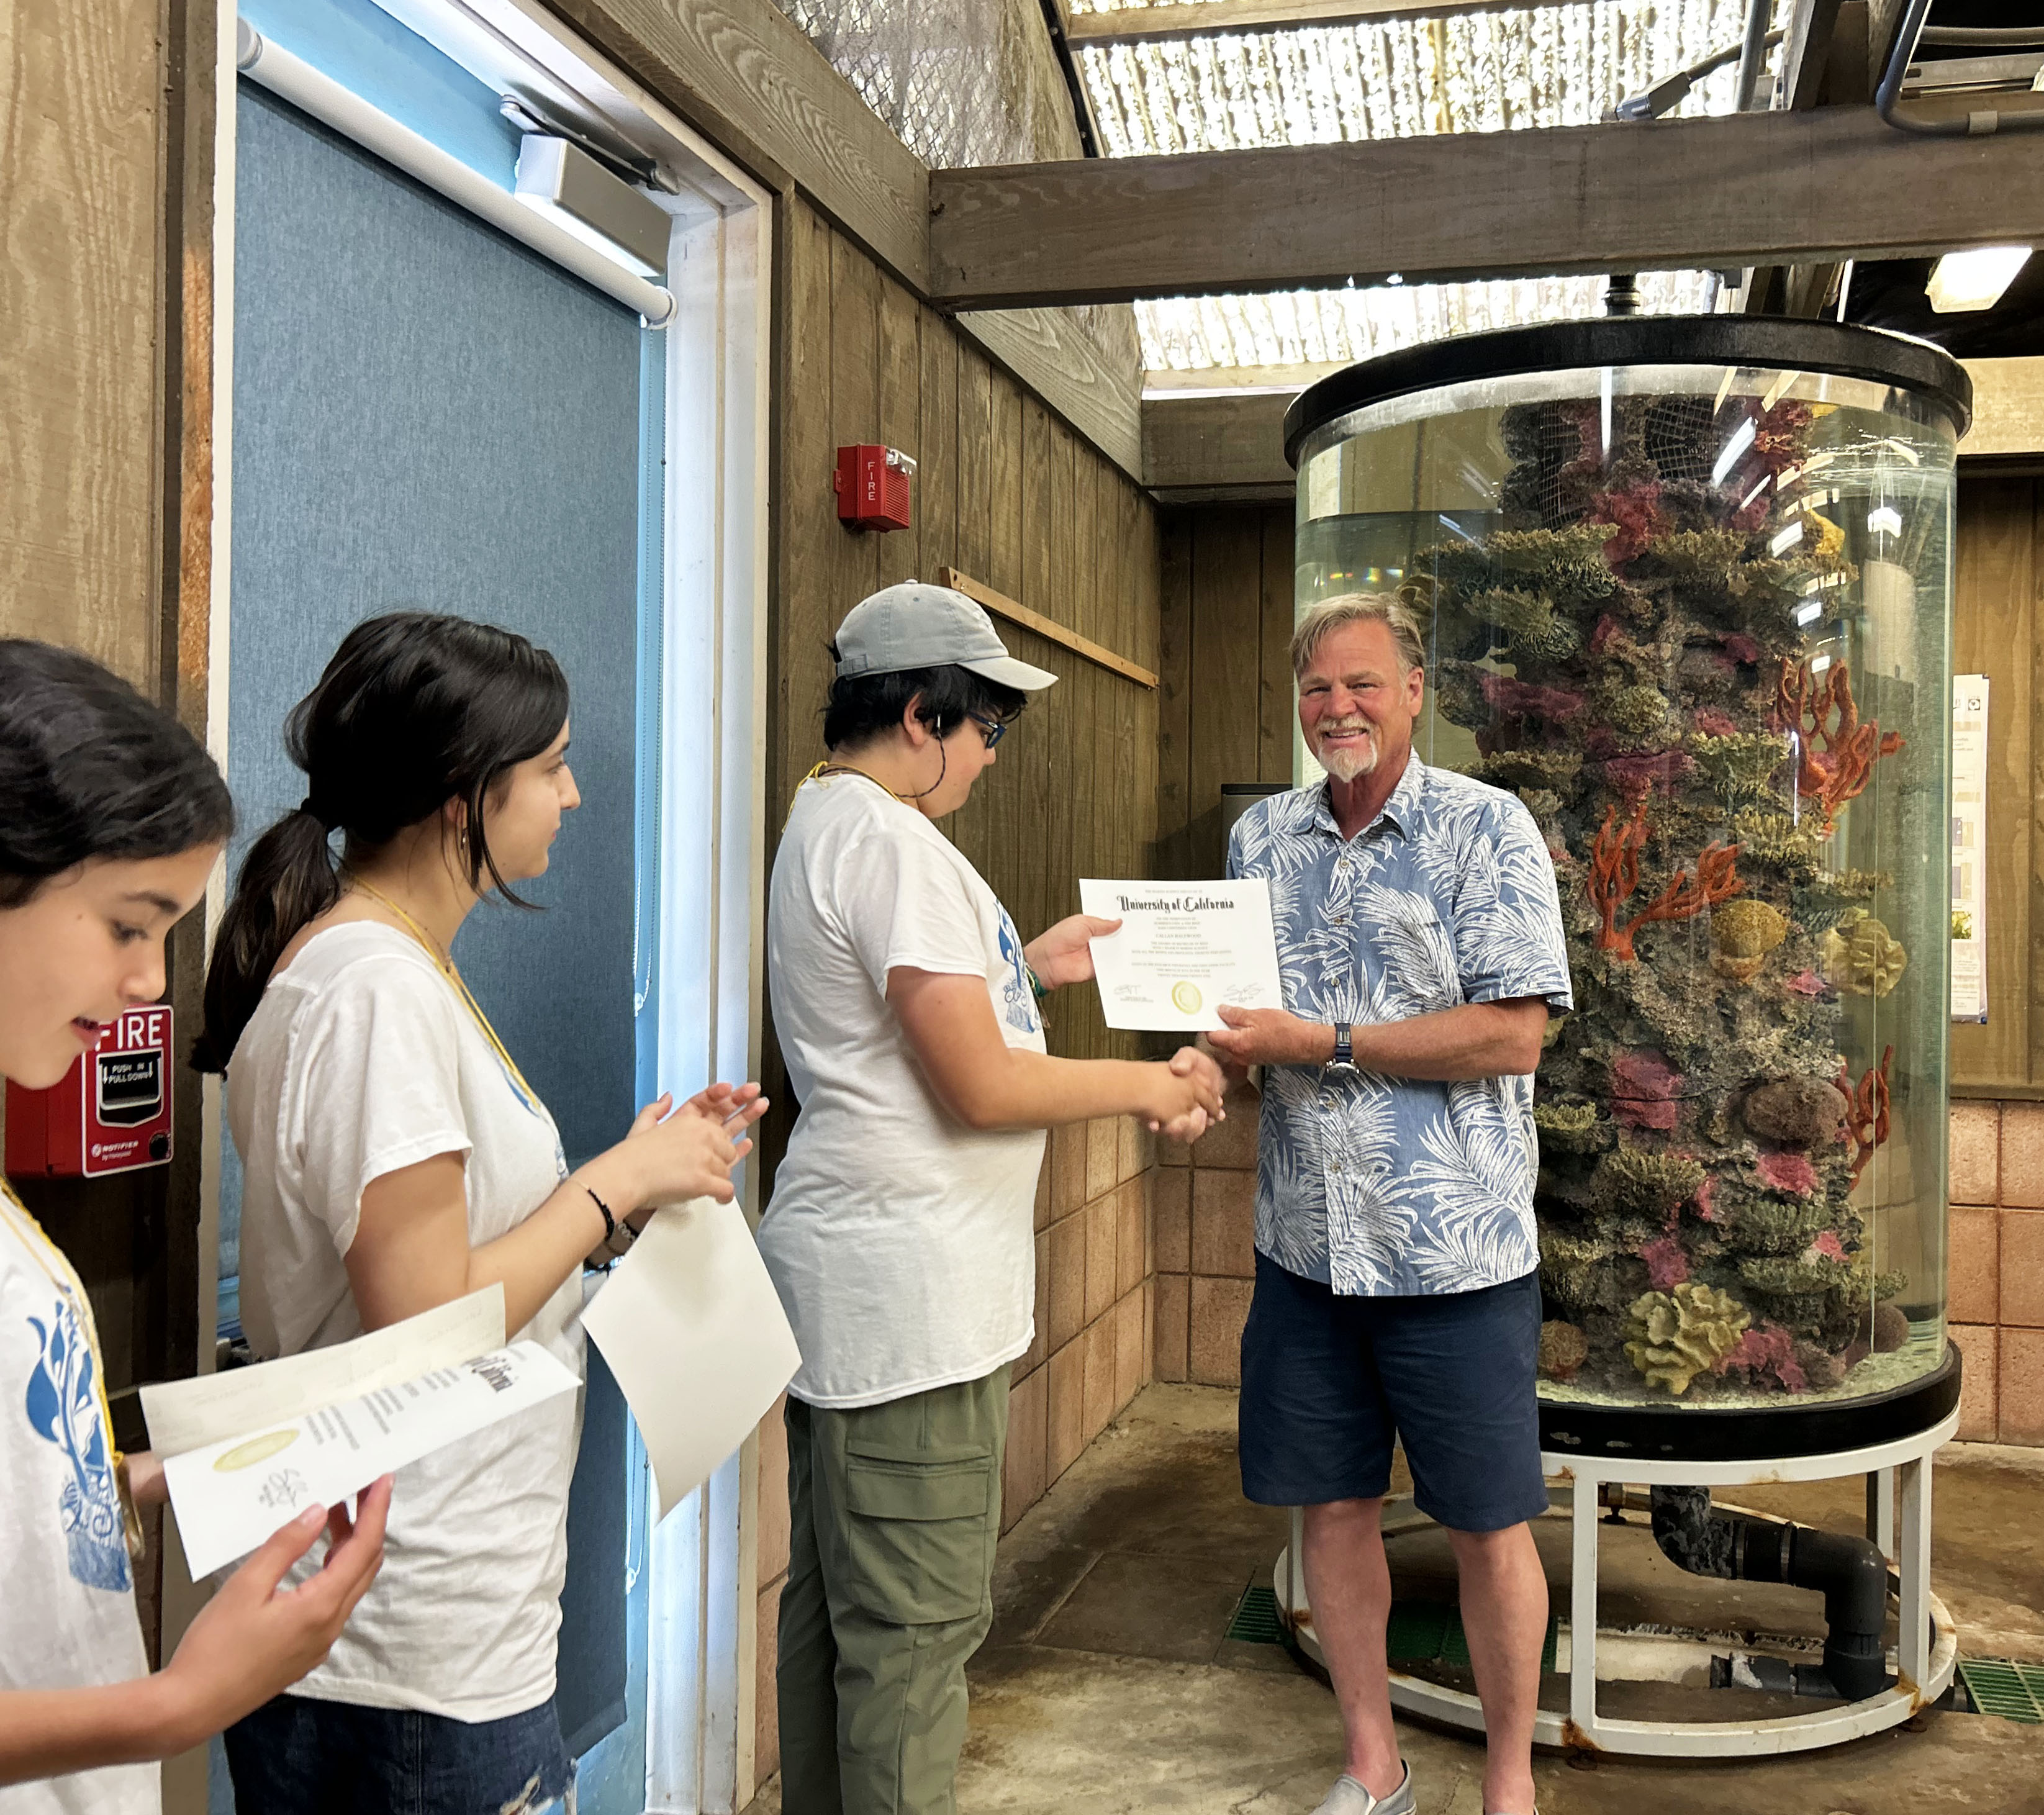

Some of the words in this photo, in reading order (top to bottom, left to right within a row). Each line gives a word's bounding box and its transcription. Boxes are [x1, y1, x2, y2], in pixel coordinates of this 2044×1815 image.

[867, 461, 875, 500] FIRE
[1116, 895, 1171, 913] University
[1172, 897, 1182, 910] of
[1183, 896, 1235, 912] California
[112, 1064, 132, 1074] PUSH
[137, 1062, 145, 1070] IN
[102, 1140, 138, 1152] NOTIFIER
